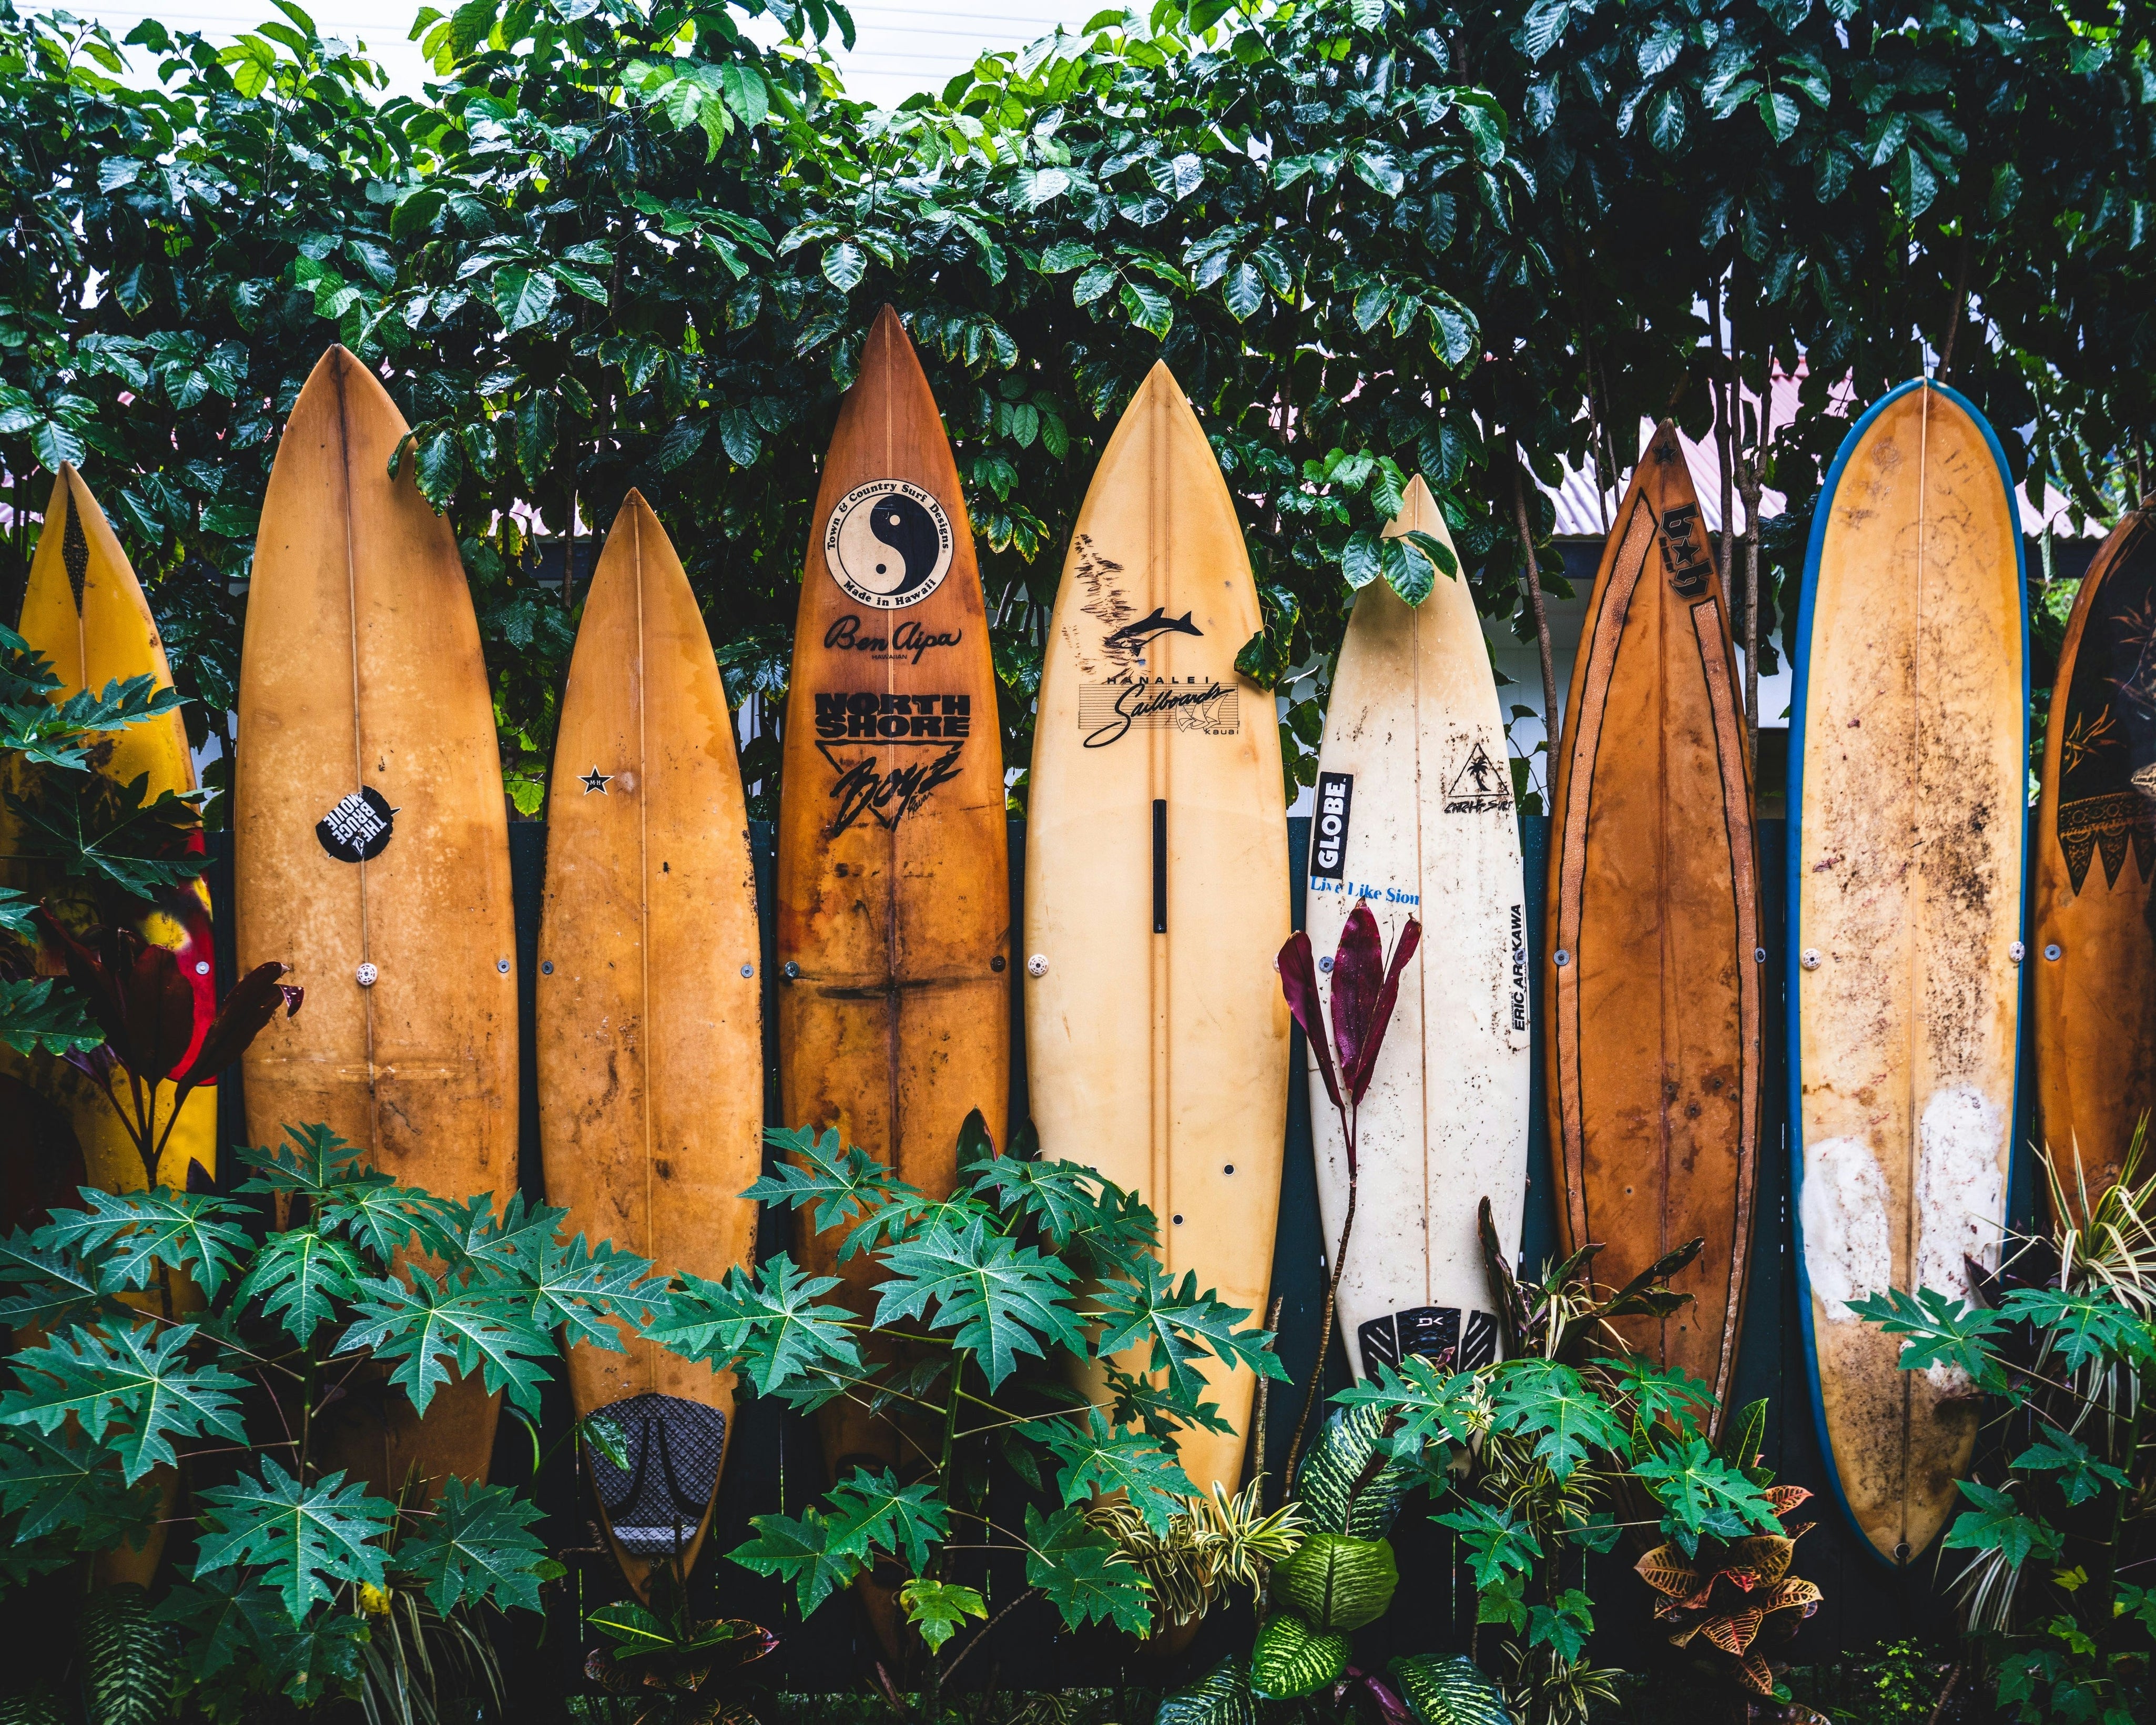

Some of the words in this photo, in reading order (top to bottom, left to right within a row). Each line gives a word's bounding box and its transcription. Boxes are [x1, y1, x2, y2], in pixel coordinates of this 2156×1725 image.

[827, 518, 840, 550] Town
[839, 503, 848, 513] &
[849, 482, 897, 502] Country
[901, 484, 928, 503] Surf
[929, 503, 949, 549] Designs
[843, 580, 871, 602] Made
[877, 597, 889, 606] in
[896, 579, 936, 605] Hawaii
[824, 615, 888, 651] Ben
[815, 693, 971, 716] NORTH
[1083, 682, 1235, 748] Sailboards
[815, 714, 971, 737] SHORE
[323, 793, 364, 831] MOVIE
[332, 801, 376, 845] BRUCE
[361, 815, 387, 843] THE
[1318, 782, 1346, 869] GLOBE
[1310, 876, 1343, 894] Live
[1348, 881, 1382, 899] Like
[1386, 887, 1419, 905] Sion
[1511, 904, 1524, 989] ARKAWA
[1513, 991, 1525, 1031] ERIC
